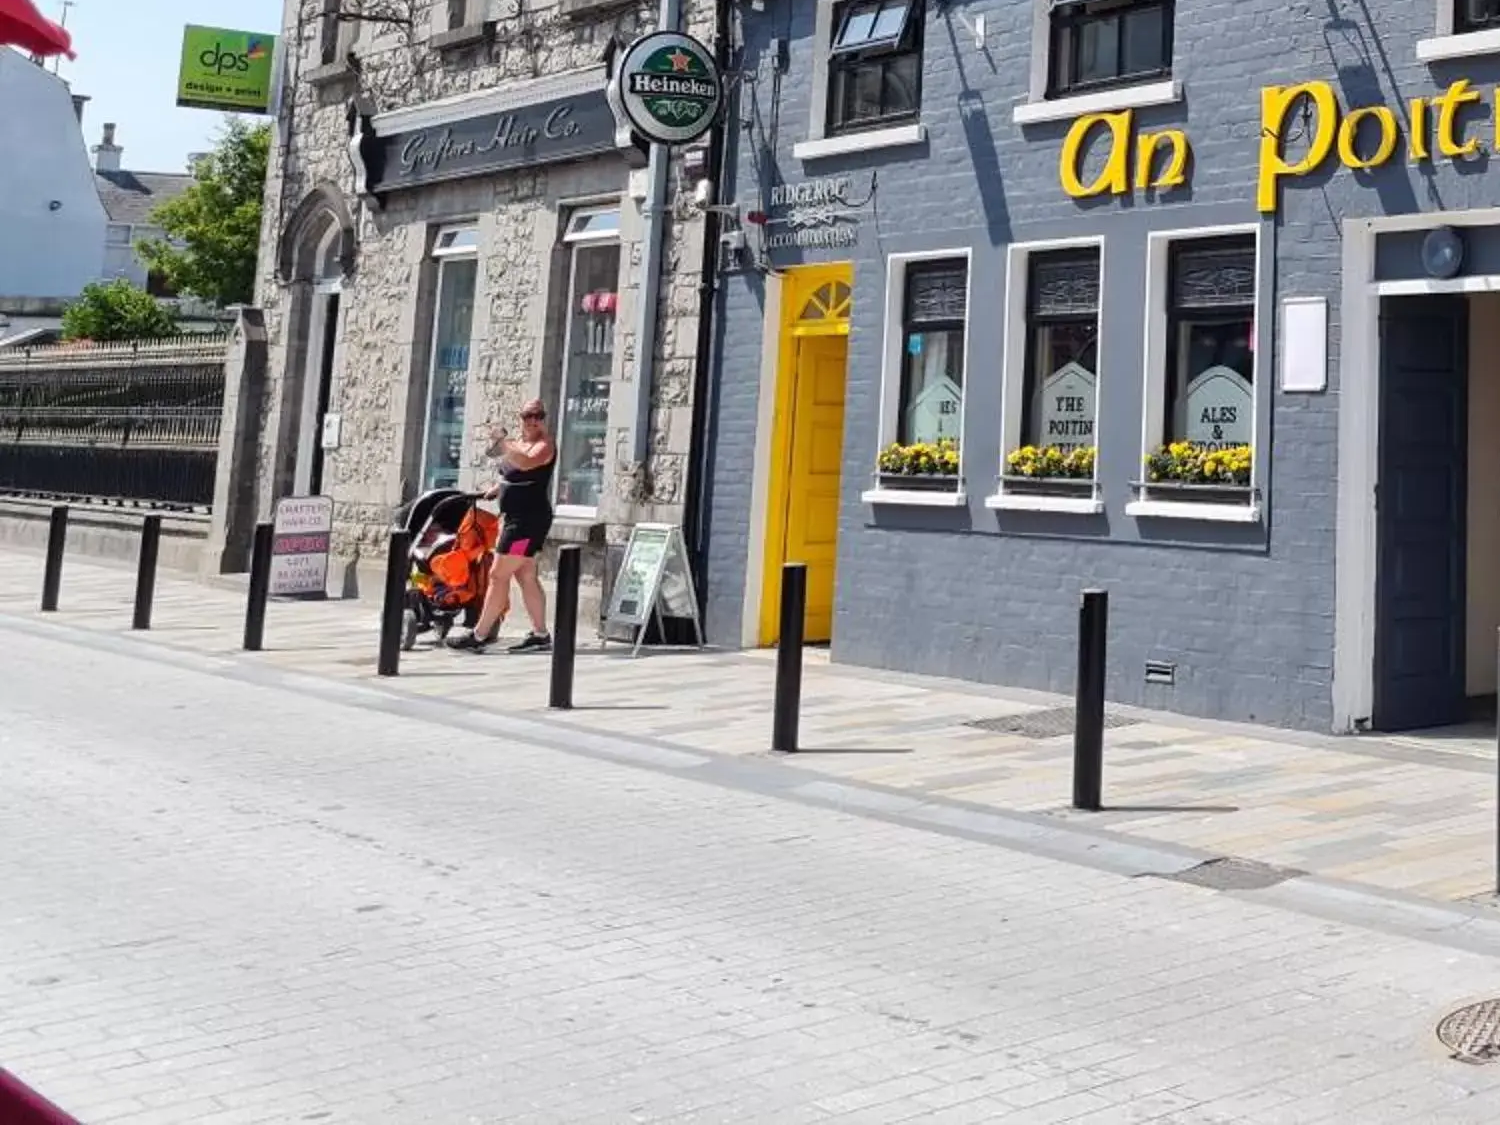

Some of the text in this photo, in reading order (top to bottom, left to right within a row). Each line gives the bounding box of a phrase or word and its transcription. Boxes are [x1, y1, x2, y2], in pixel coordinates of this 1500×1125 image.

[200, 42, 249, 75] dps
[634, 74, 715, 97] Heineken
[478, 115, 538, 154] Hair
[1056, 396, 1085, 412] THE
[1200, 406, 1237, 424] ALES
[1211, 424, 1223, 440] &
